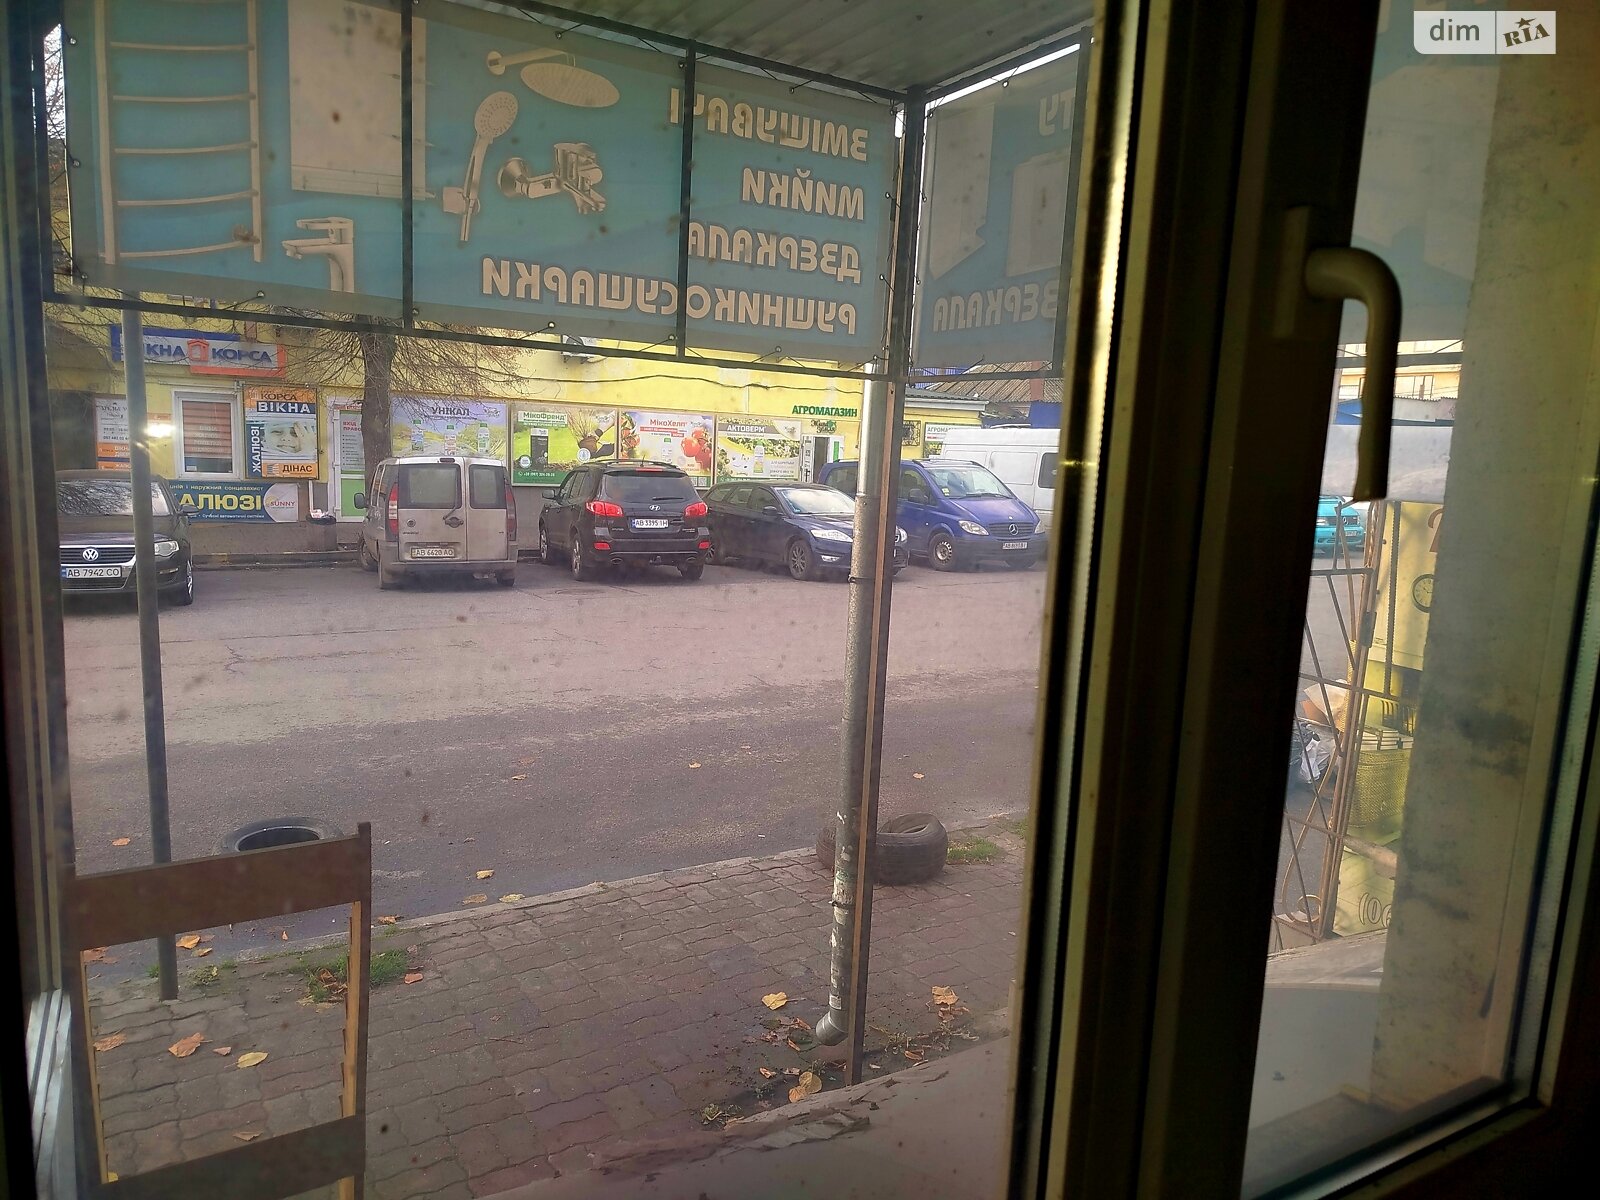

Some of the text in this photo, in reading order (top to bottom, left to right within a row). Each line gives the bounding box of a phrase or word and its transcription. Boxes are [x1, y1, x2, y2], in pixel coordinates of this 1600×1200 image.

[212, 347, 273, 363] КОРСА
[261, 393, 297, 401] КОРСА
[258, 401, 311, 413] ВІКНА
[431, 406, 470, 416] УНІКАЛ
[792, 405, 858, 417] АГРОМАГАЗИН
[727, 424, 765, 433] АКТОВЕРМ
[251, 426, 262, 473] ЖАЛЮЗІ
[283, 464, 313, 473] ДІНАС
[180, 493, 262, 511] АЛЮЗІ
[83, 569, 104, 577] 7942
